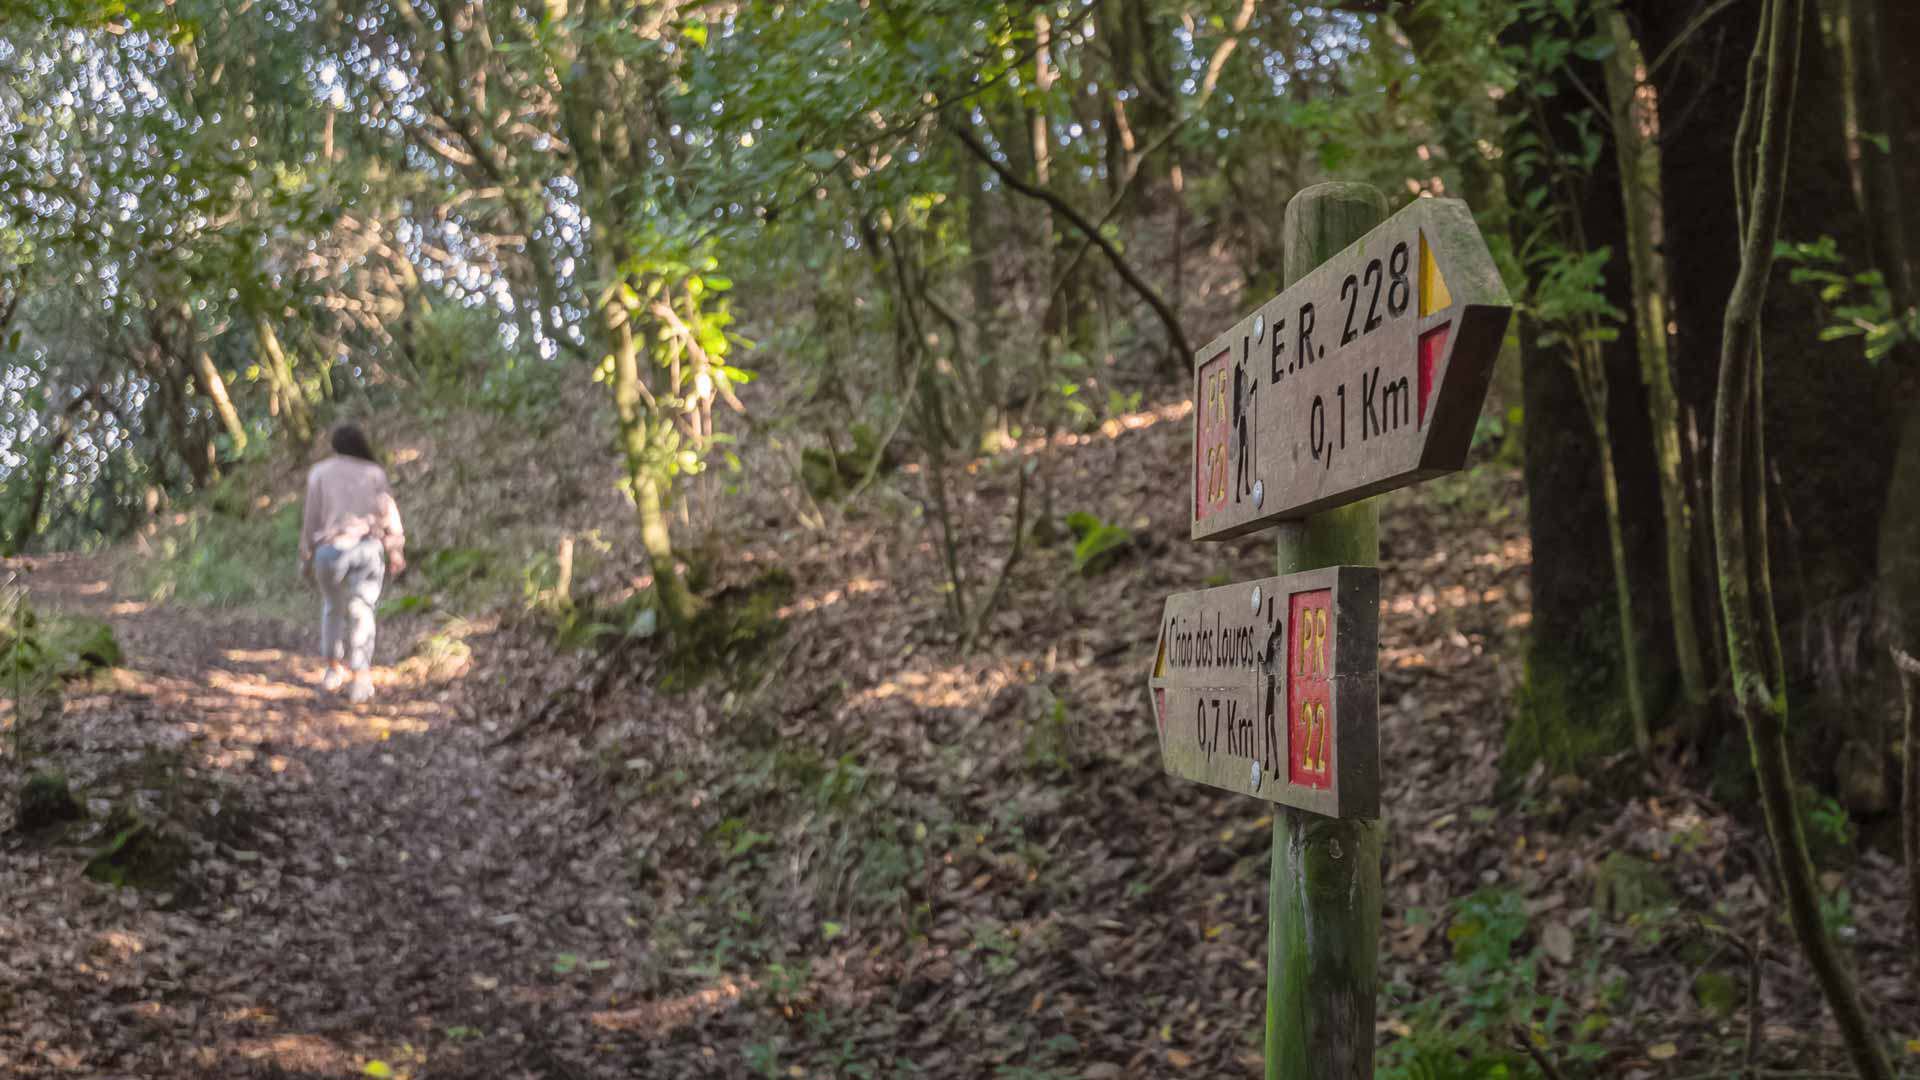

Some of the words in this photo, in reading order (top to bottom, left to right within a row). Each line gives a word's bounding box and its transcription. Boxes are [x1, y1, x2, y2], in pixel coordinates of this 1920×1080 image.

[1271, 302, 1325, 385] E.R.
[1340, 240, 1411, 348] 228
[1206, 367, 1226, 433] PR
[1310, 383, 1346, 471] 0,1
[1362, 366, 1409, 441] Km
[1207, 442, 1226, 503] 22
[1195, 611, 1213, 668] dos
[1216, 611, 1254, 668] Louros
[1300, 607, 1327, 676] PR
[1197, 697, 1221, 764] 0,7
[1226, 699, 1254, 760] Km
[1301, 701, 1326, 773] 22
